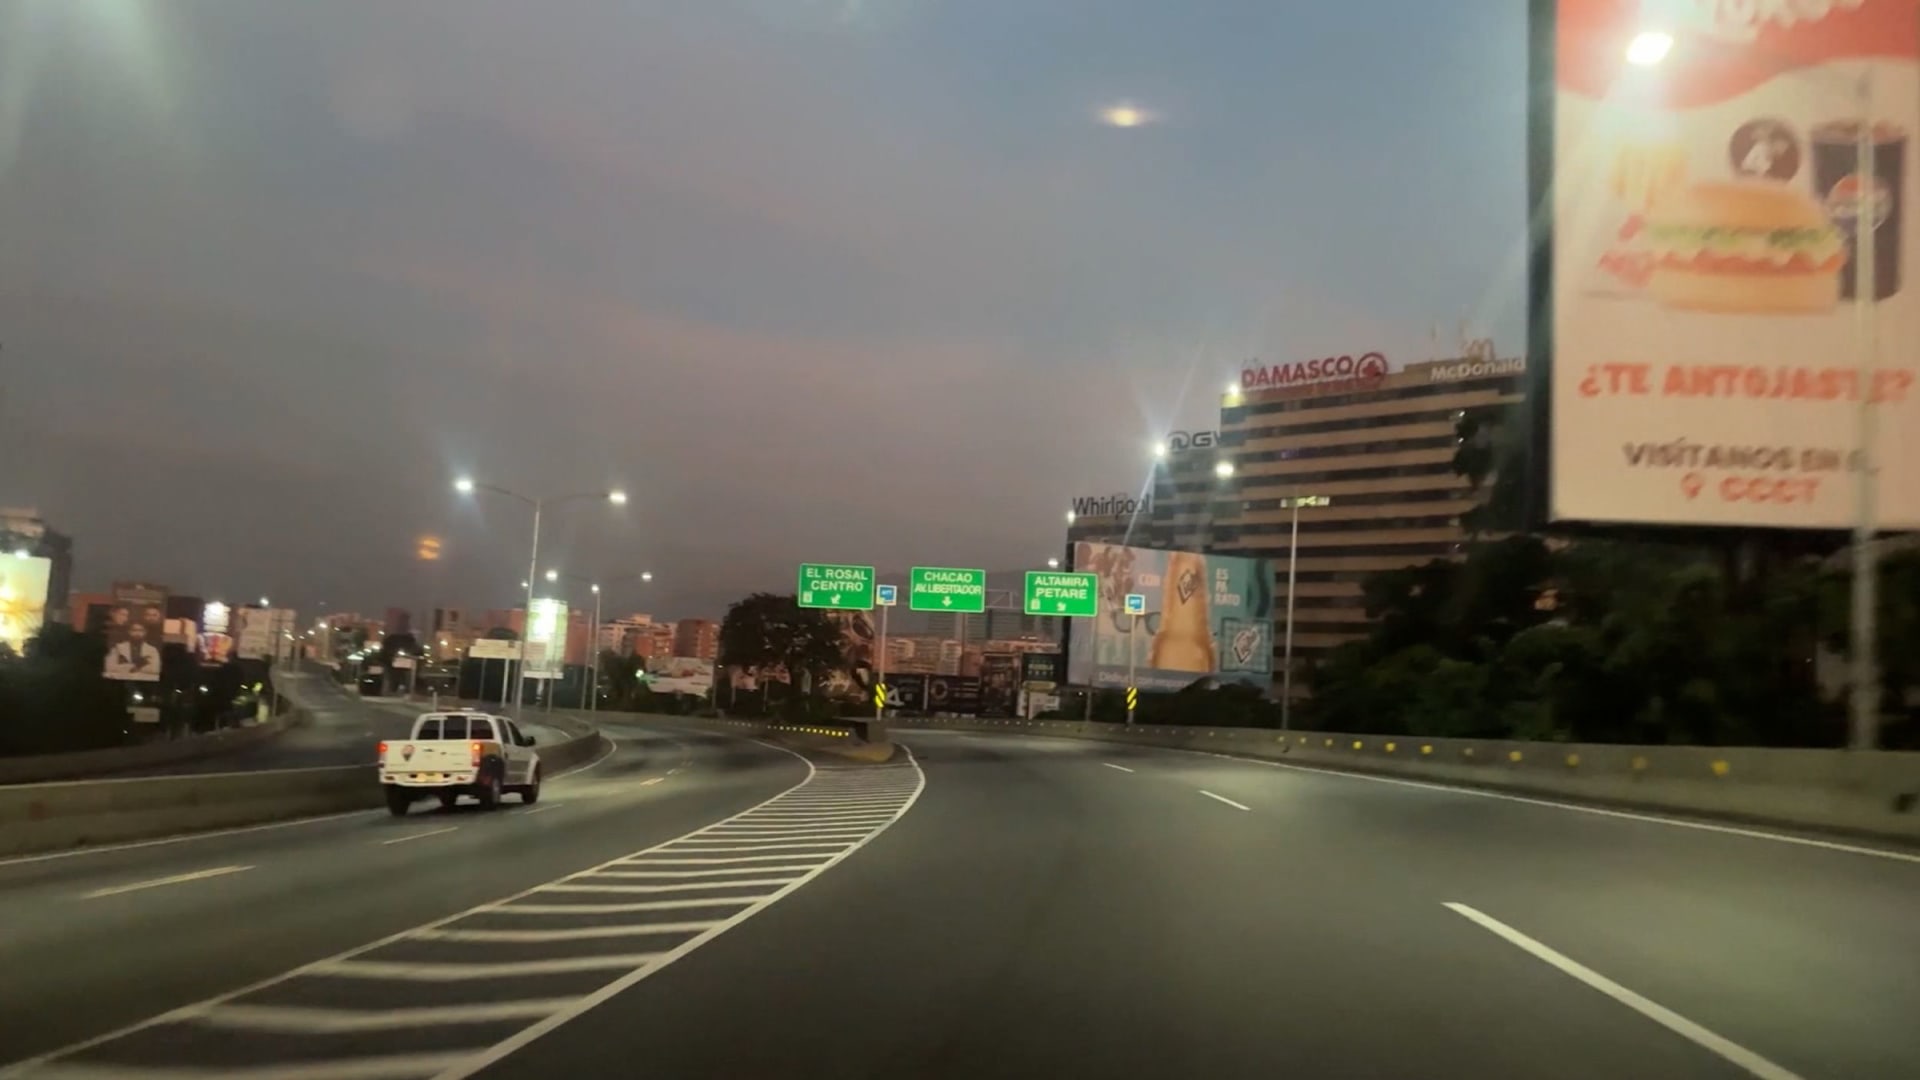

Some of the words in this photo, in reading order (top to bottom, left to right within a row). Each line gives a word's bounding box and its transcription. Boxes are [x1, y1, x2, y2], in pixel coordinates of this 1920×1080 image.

[1241, 355, 1354, 388] DAMASCO
[1579, 362, 1652, 397] ¿TE
[1622, 437, 1795, 471] VISÍTANOS
[1801, 447, 1840, 473] EN
[1072, 493, 1149, 519] Whirlpool
[806, 568, 821, 578] EL
[825, 569, 868, 580] ROSAL
[924, 571, 973, 583] CHACAO
[811, 580, 864, 592] CENTRO
[1035, 576, 1089, 587] ALTAMIRA
[1035, 587, 1088, 599] PETARE
